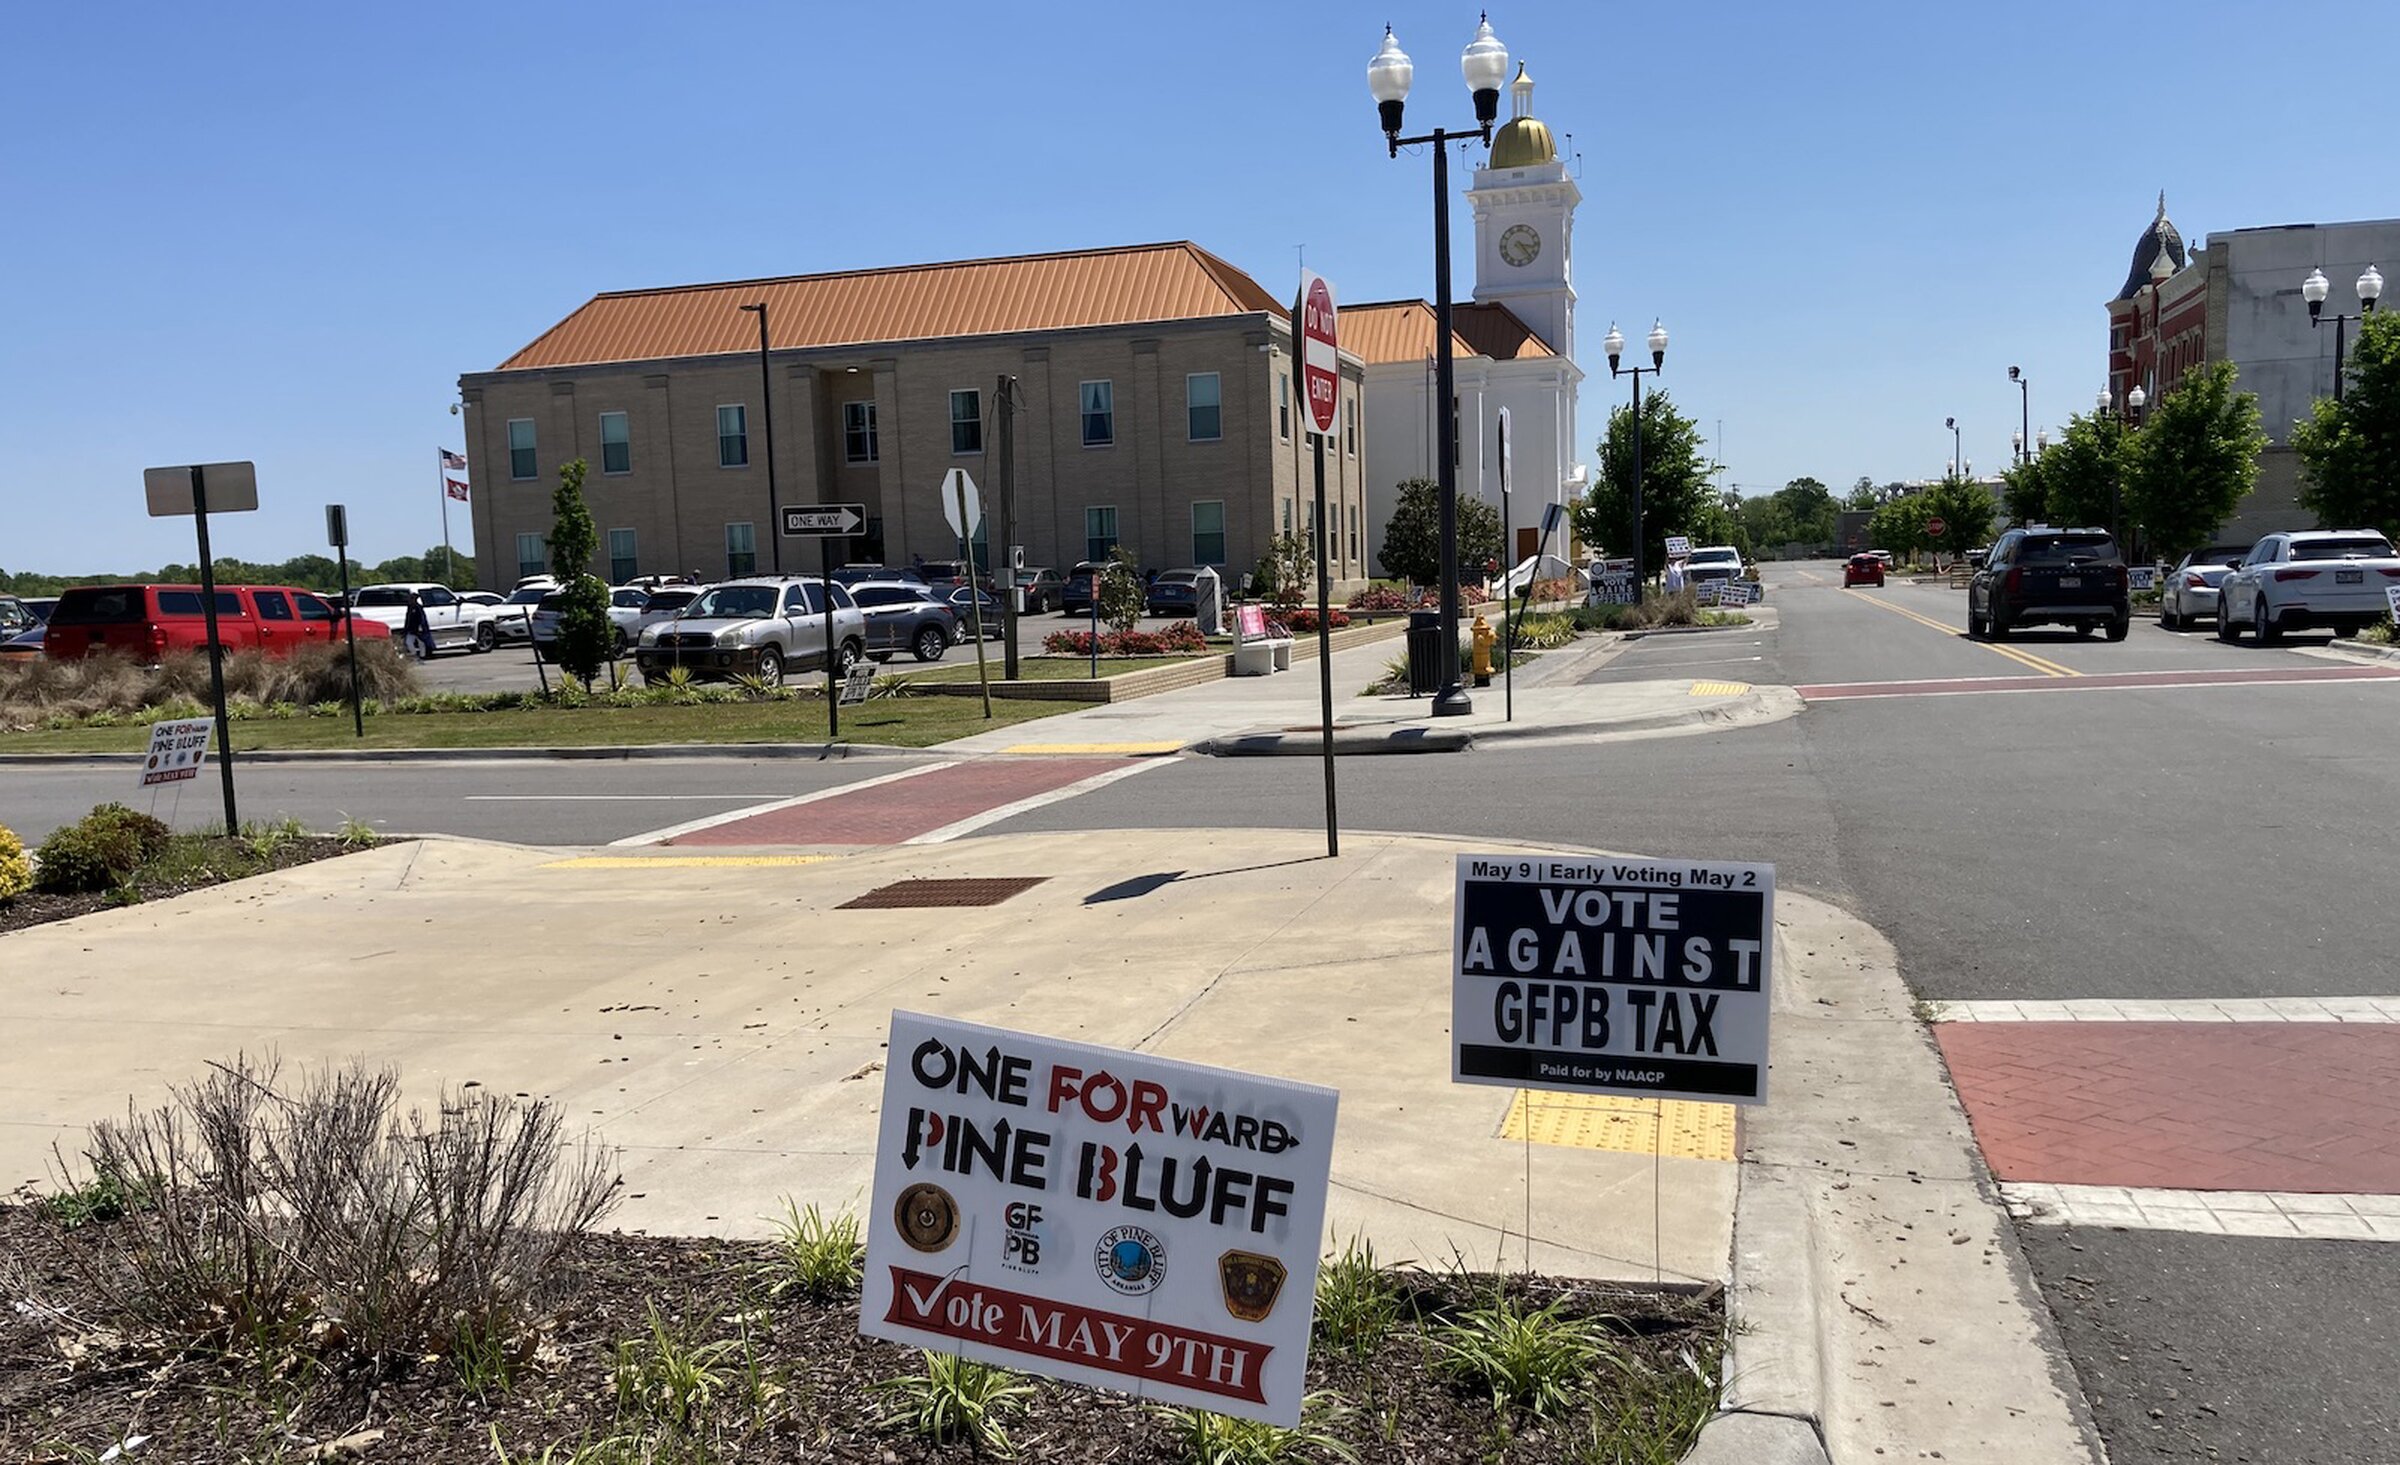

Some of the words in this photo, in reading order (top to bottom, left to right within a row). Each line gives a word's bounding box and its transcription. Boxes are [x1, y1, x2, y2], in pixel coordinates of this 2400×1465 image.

[1308, 304, 1318, 330] DO
[1320, 310, 1333, 336] NOT
[1311, 375, 1333, 402] ENTER
[791, 515, 813, 527] ONE
[817, 515, 840, 526] WAY
[151, 739, 175, 753] PINE
[176, 736, 206, 750] BLUFF
[156, 726, 174, 737] ONE
[1472, 861, 1513, 880] May
[1519, 863, 1531, 878] 9
[1550, 864, 1605, 884] Early
[1612, 866, 1682, 886] Voting
[1690, 869, 1736, 888] May
[1743, 871, 1756, 886] 2
[1539, 889, 1680, 931] VOTE
[1464, 927, 1760, 985] AGAINST
[1495, 981, 1610, 1049] GFPB
[1627, 989, 1720, 1057] TAX
[911, 1037, 1032, 1107] ONE
[1540, 1063, 1568, 1078] Paid
[1572, 1065, 1592, 1079] for
[1595, 1067, 1612, 1082] by
[1615, 1069, 1665, 1083] NAACP
[902, 1107, 1051, 1190] PINE
[1077, 1141, 1294, 1232] BLUFF
[1005, 1202, 1043, 1231] GF
[1004, 1235, 1040, 1265] PB
[1103, 1231, 1119, 1247] OF
[1120, 1227, 1153, 1247] PINE
[1098, 1247, 1113, 1278] CITY
[1149, 1245, 1164, 1286] BLUFF
[1017, 1305, 1134, 1363] MAY
[1145, 1332, 1249, 1389] 9TH
